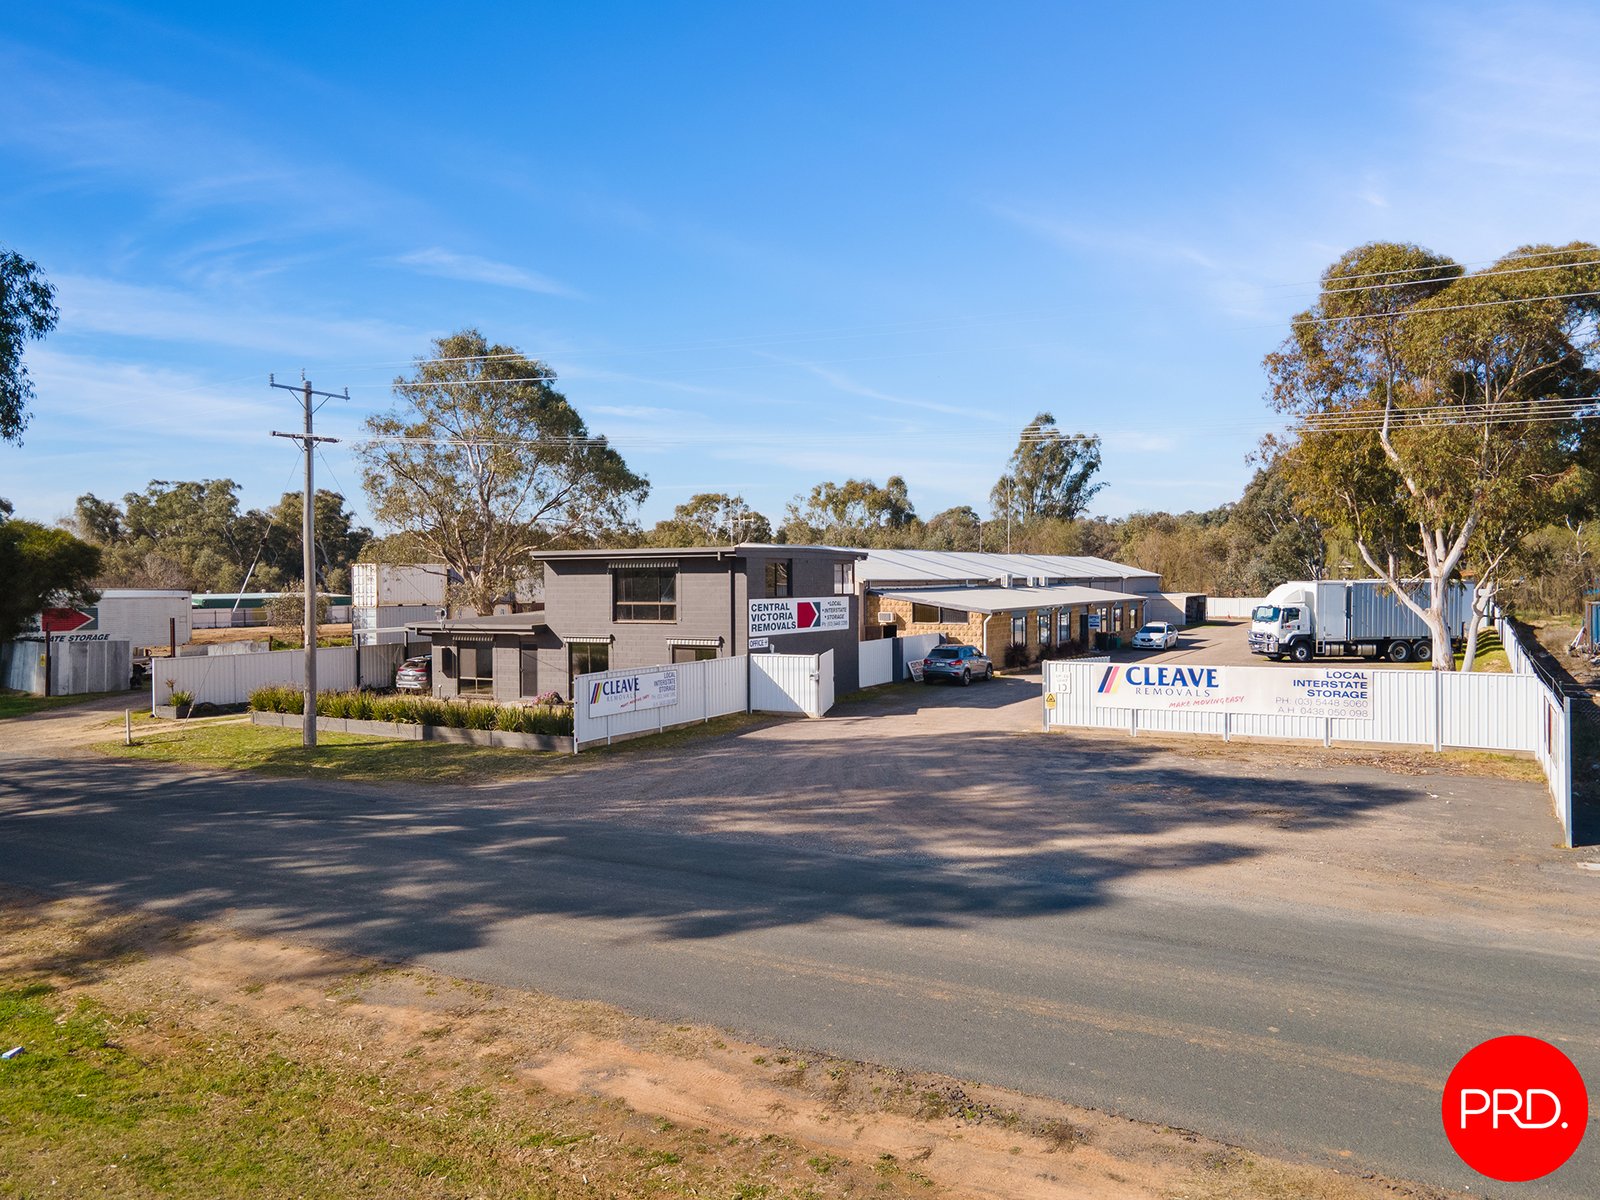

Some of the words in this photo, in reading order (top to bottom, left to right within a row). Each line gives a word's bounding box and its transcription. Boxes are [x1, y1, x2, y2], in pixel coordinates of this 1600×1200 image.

[751, 603, 790, 612] CENTRAL
[751, 612, 794, 622] VICTORIA
[751, 621, 797, 632] REMOVALS
[68, 634, 110, 642] STORAGE
[749, 639, 764, 647] OFFICE
[1125, 666, 1219, 688] CLEAVE
[1326, 671, 1368, 680] LOCAL
[603, 677, 640, 695] CLEAVE
[1293, 680, 1368, 690] INTERSTATE
[1135, 687, 1211, 698] REMOVALS
[1307, 689, 1368, 699] STORAGE
[1169, 700, 1190, 708] MAKE
[1193, 697, 1225, 706] MOVING
[1225, 695, 1245, 704] EASY
[1294, 698, 1313, 706] (03)
[1315, 699, 1340, 707] 5448
[1343, 700, 1368, 708] 5060
[1300, 707, 1325, 715] 0438
[1328, 708, 1347, 716] 050
